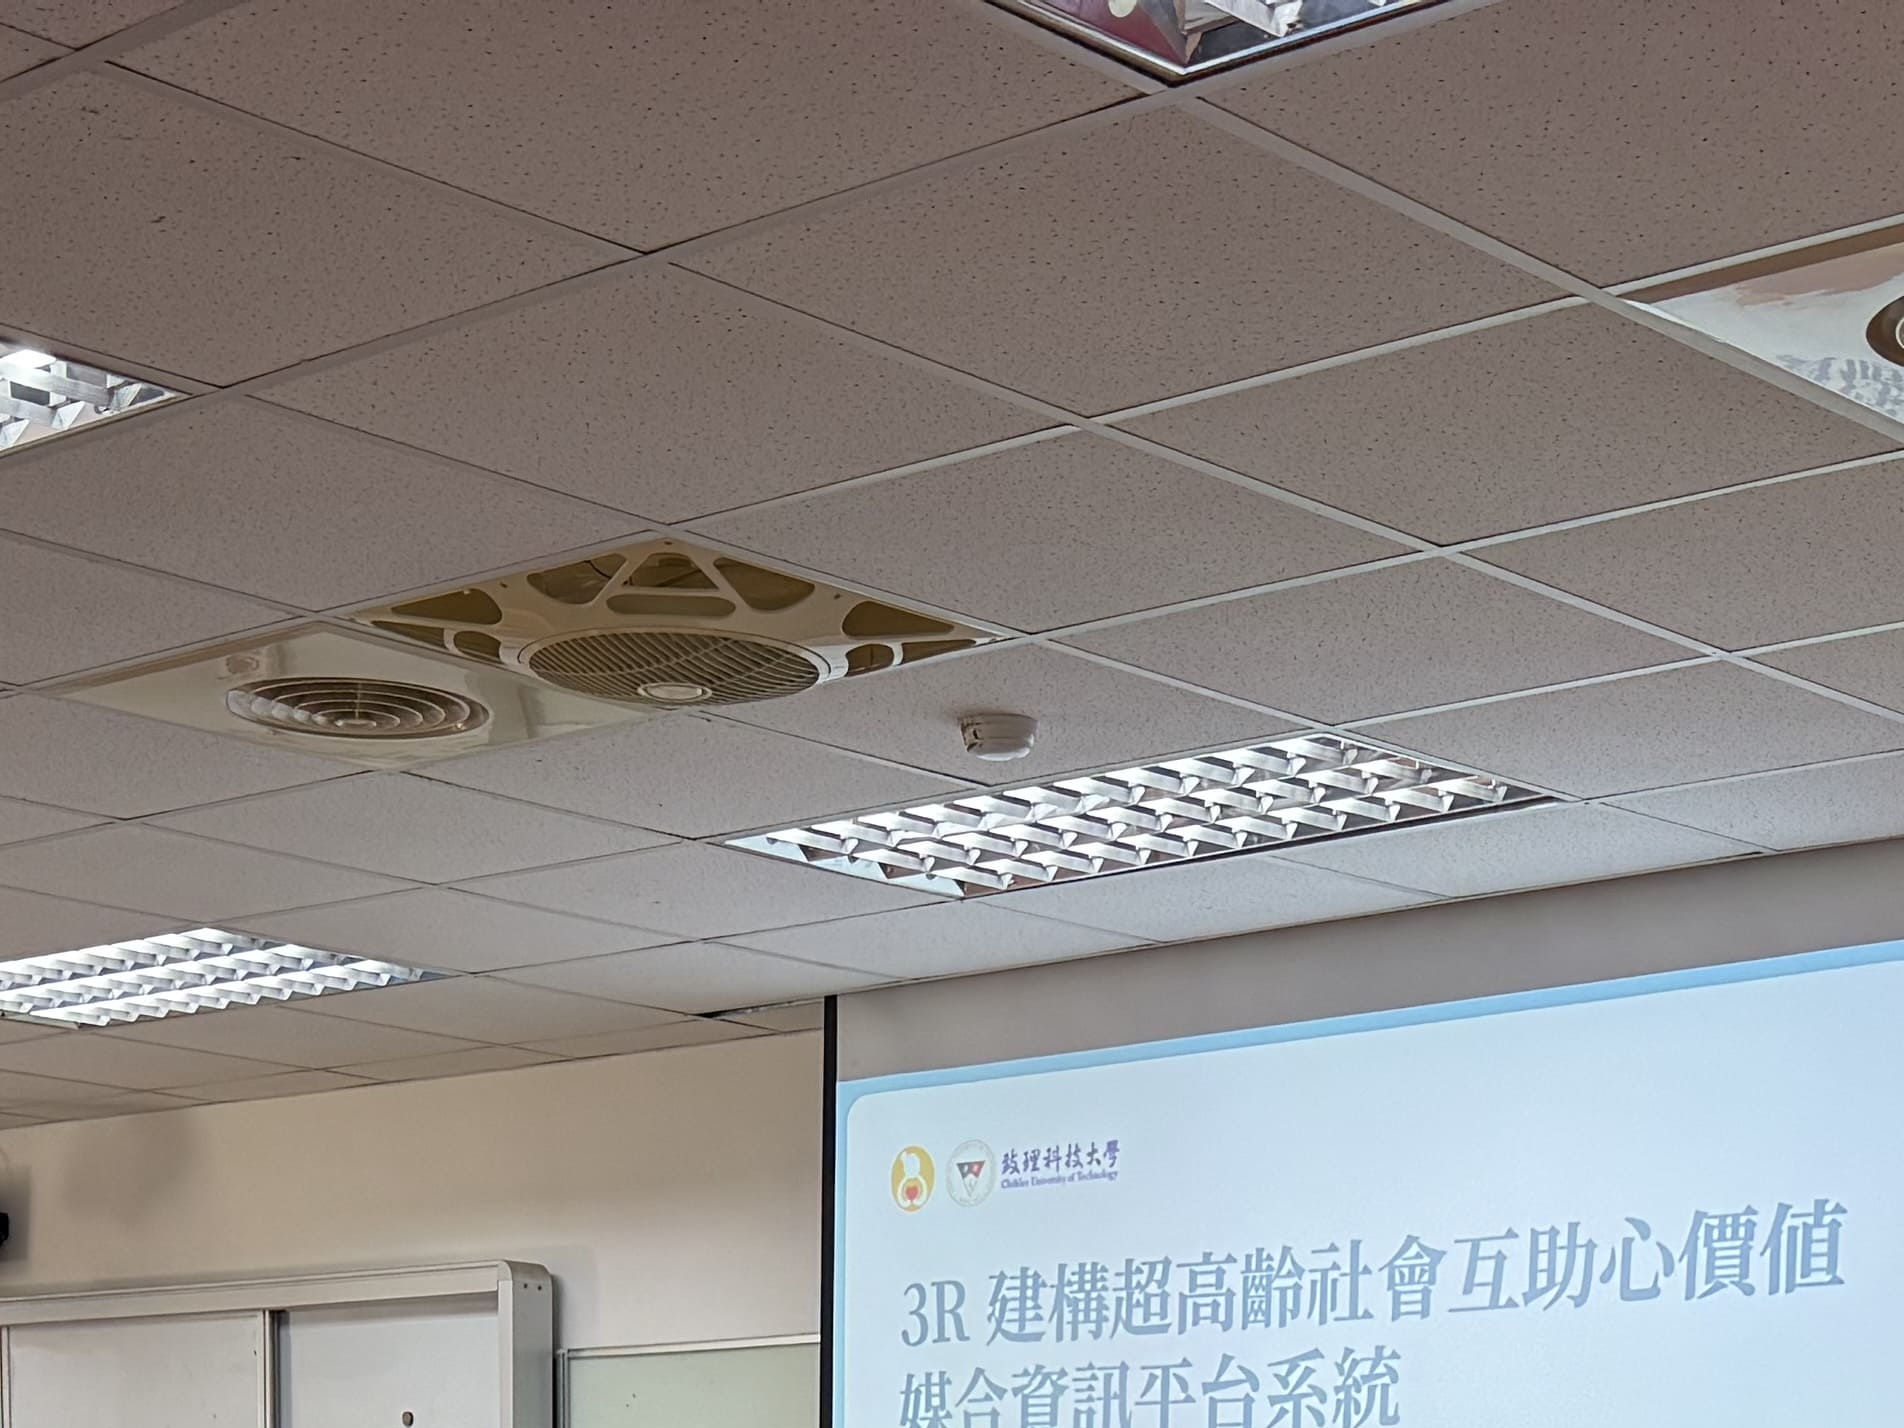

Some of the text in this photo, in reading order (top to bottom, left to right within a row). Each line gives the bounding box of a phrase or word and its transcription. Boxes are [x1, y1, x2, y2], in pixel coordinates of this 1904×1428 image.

[1000, 1139, 1120, 1176] 致理科技大學
[1031, 1174, 1066, 1187] University
[1075, 1169, 1118, 1181] Technology
[901, 1198, 1848, 1347] 3R 建構超高齡社會互助心價值
